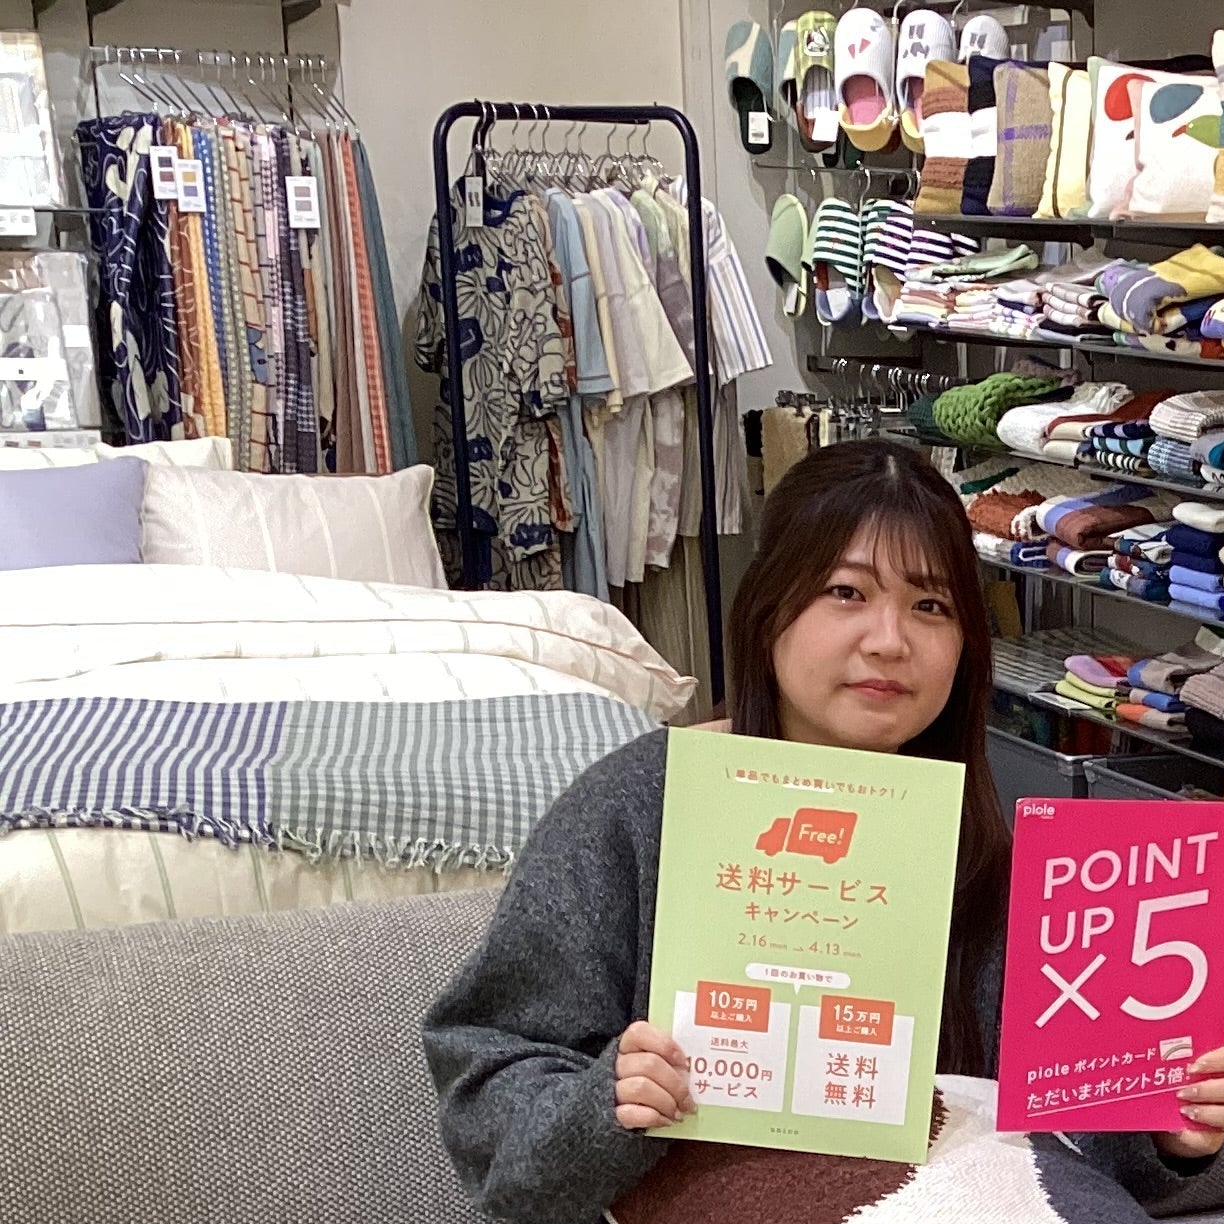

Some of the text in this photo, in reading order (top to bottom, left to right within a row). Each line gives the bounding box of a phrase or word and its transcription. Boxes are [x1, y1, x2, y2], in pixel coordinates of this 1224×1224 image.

[1023, 803, 1055, 818] piole
[799, 823, 845, 845] Free!
[1043, 831, 1219, 900] POINT
[716, 862, 888, 905] 送料サービス
[745, 902, 858, 930] キャンペーン
[738, 932, 767, 947] 2.16
[808, 941, 840, 956] 4.13
[1040, 906, 1115, 955] UP
[1119, 889, 1209, 1021] 5
[709, 990, 758, 1012] 10万円
[833, 1004, 881, 1025] 15万円
[825, 1052, 879, 1081] 送料
[1027, 1047, 1156, 1084] piole ポイントカード
[695, 1080, 758, 1098] サービス
[824, 1081, 876, 1109] 無料
